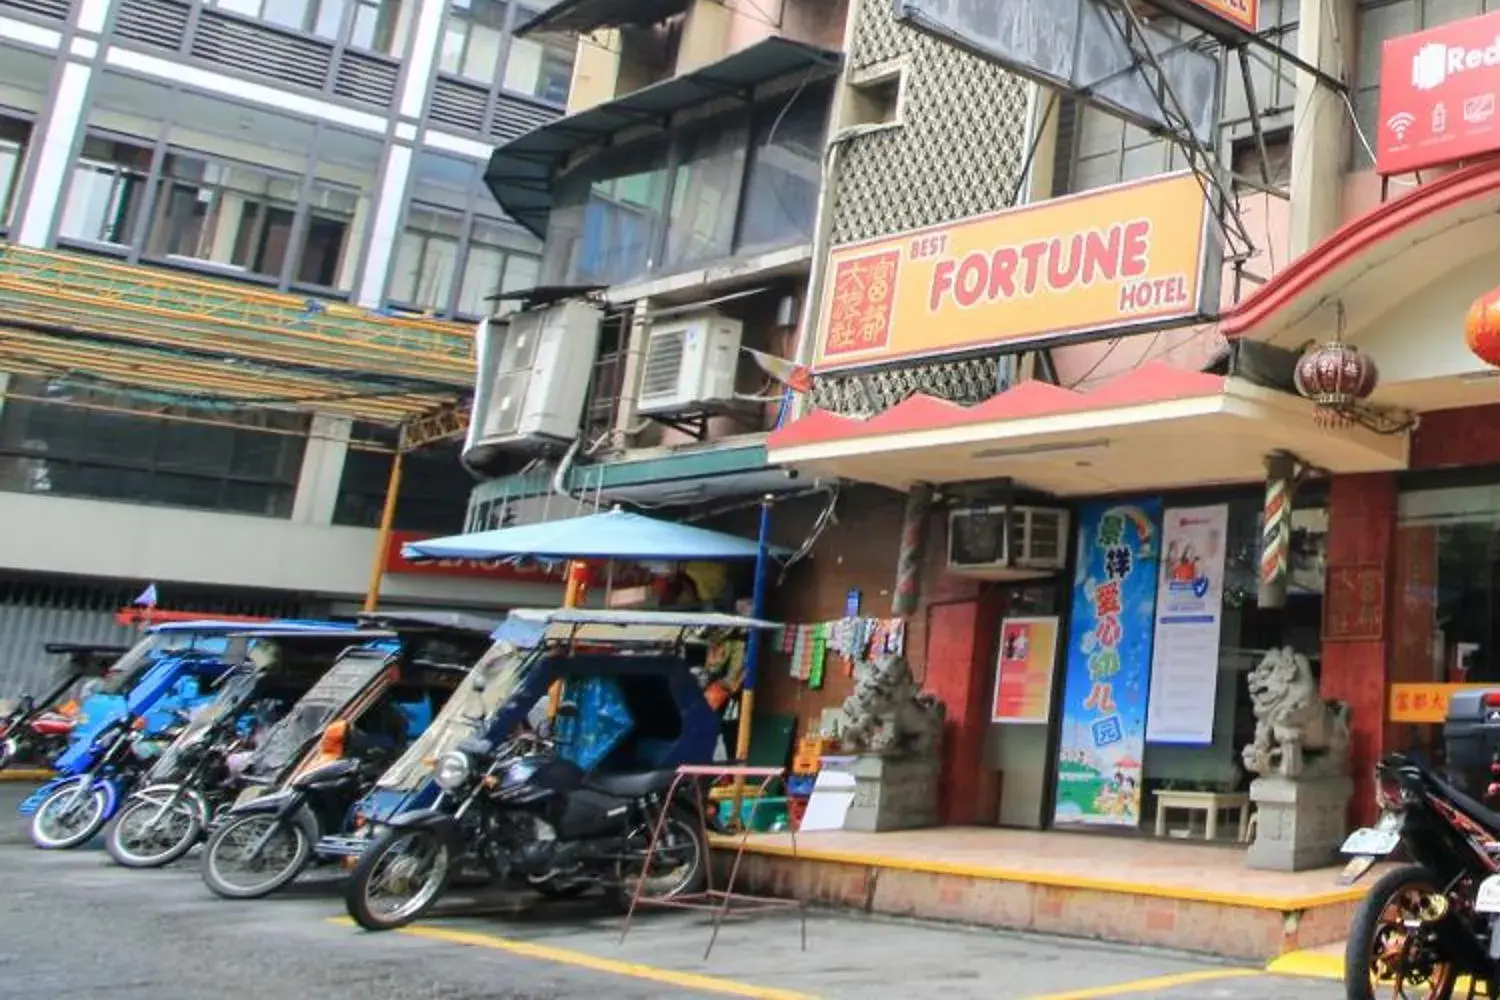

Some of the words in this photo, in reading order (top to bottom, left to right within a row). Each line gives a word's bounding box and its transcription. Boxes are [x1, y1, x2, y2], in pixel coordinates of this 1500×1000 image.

[909, 234, 947, 261] BEST
[928, 220, 1150, 312] FORTUNE
[1119, 277, 1187, 312] HOTEL
